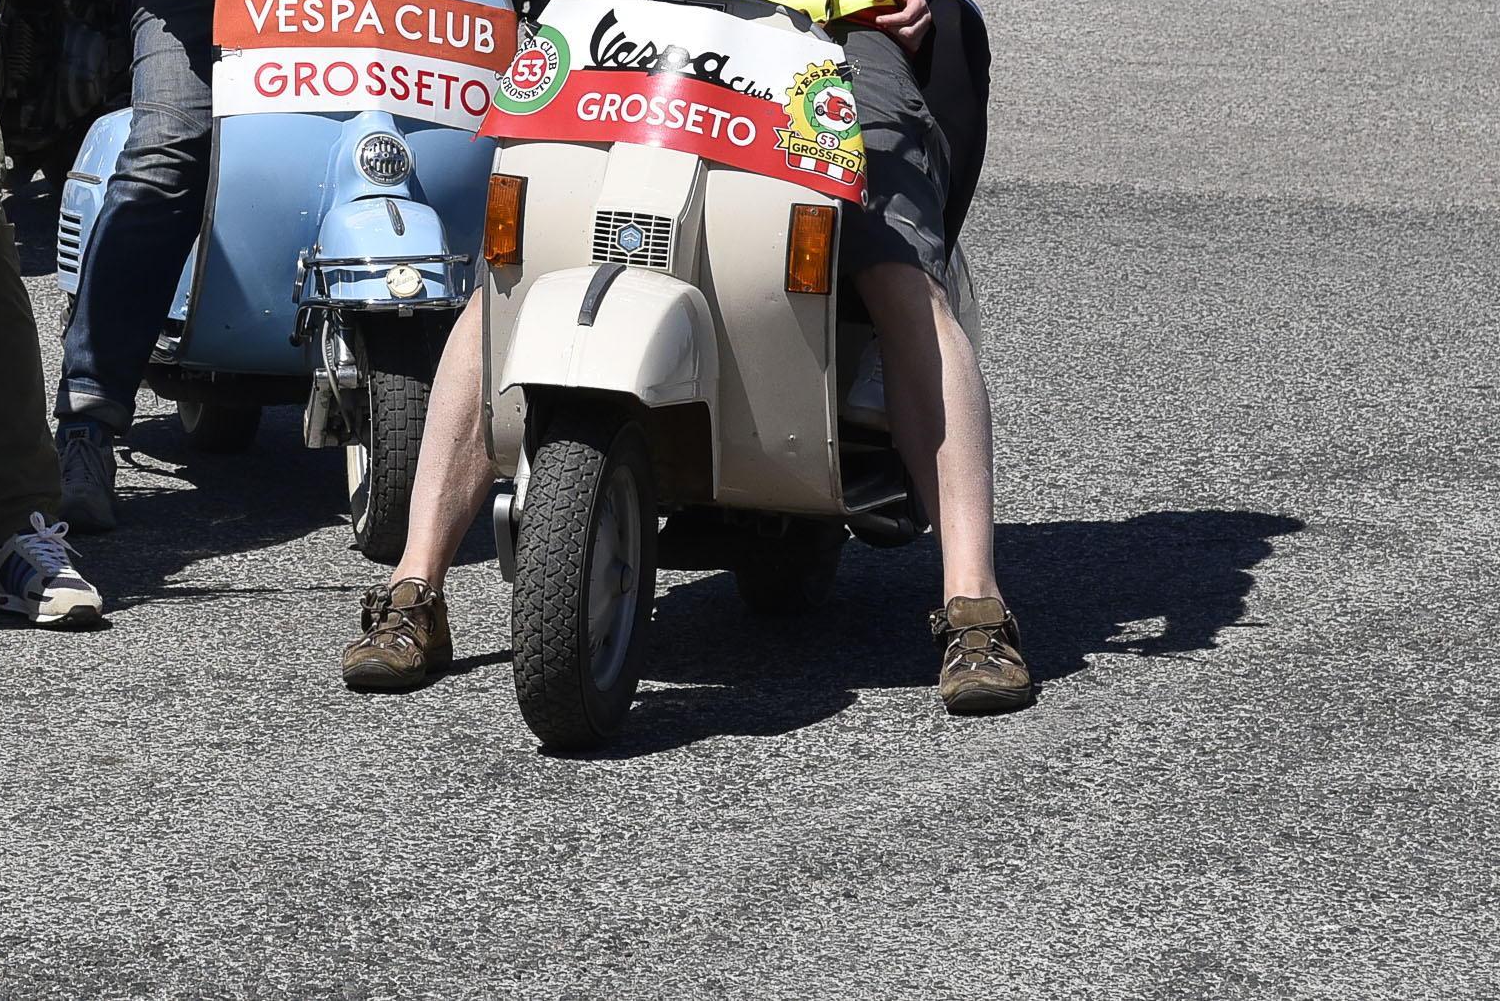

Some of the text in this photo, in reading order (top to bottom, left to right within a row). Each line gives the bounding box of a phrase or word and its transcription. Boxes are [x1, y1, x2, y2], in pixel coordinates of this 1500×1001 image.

[394, 3, 496, 54] CLUB
[540, 41, 558, 71] CLUB
[581, 8, 734, 85] Vespa
[513, 58, 545, 82] 53
[794, 68, 840, 97] VESPA
[254, 61, 490, 117] GROSSETO
[502, 76, 552, 100] GROSSETO
[576, 92, 758, 147] GROSSETO
[792, 142, 856, 169] GROSSETO
[819, 134, 836, 148] 53
